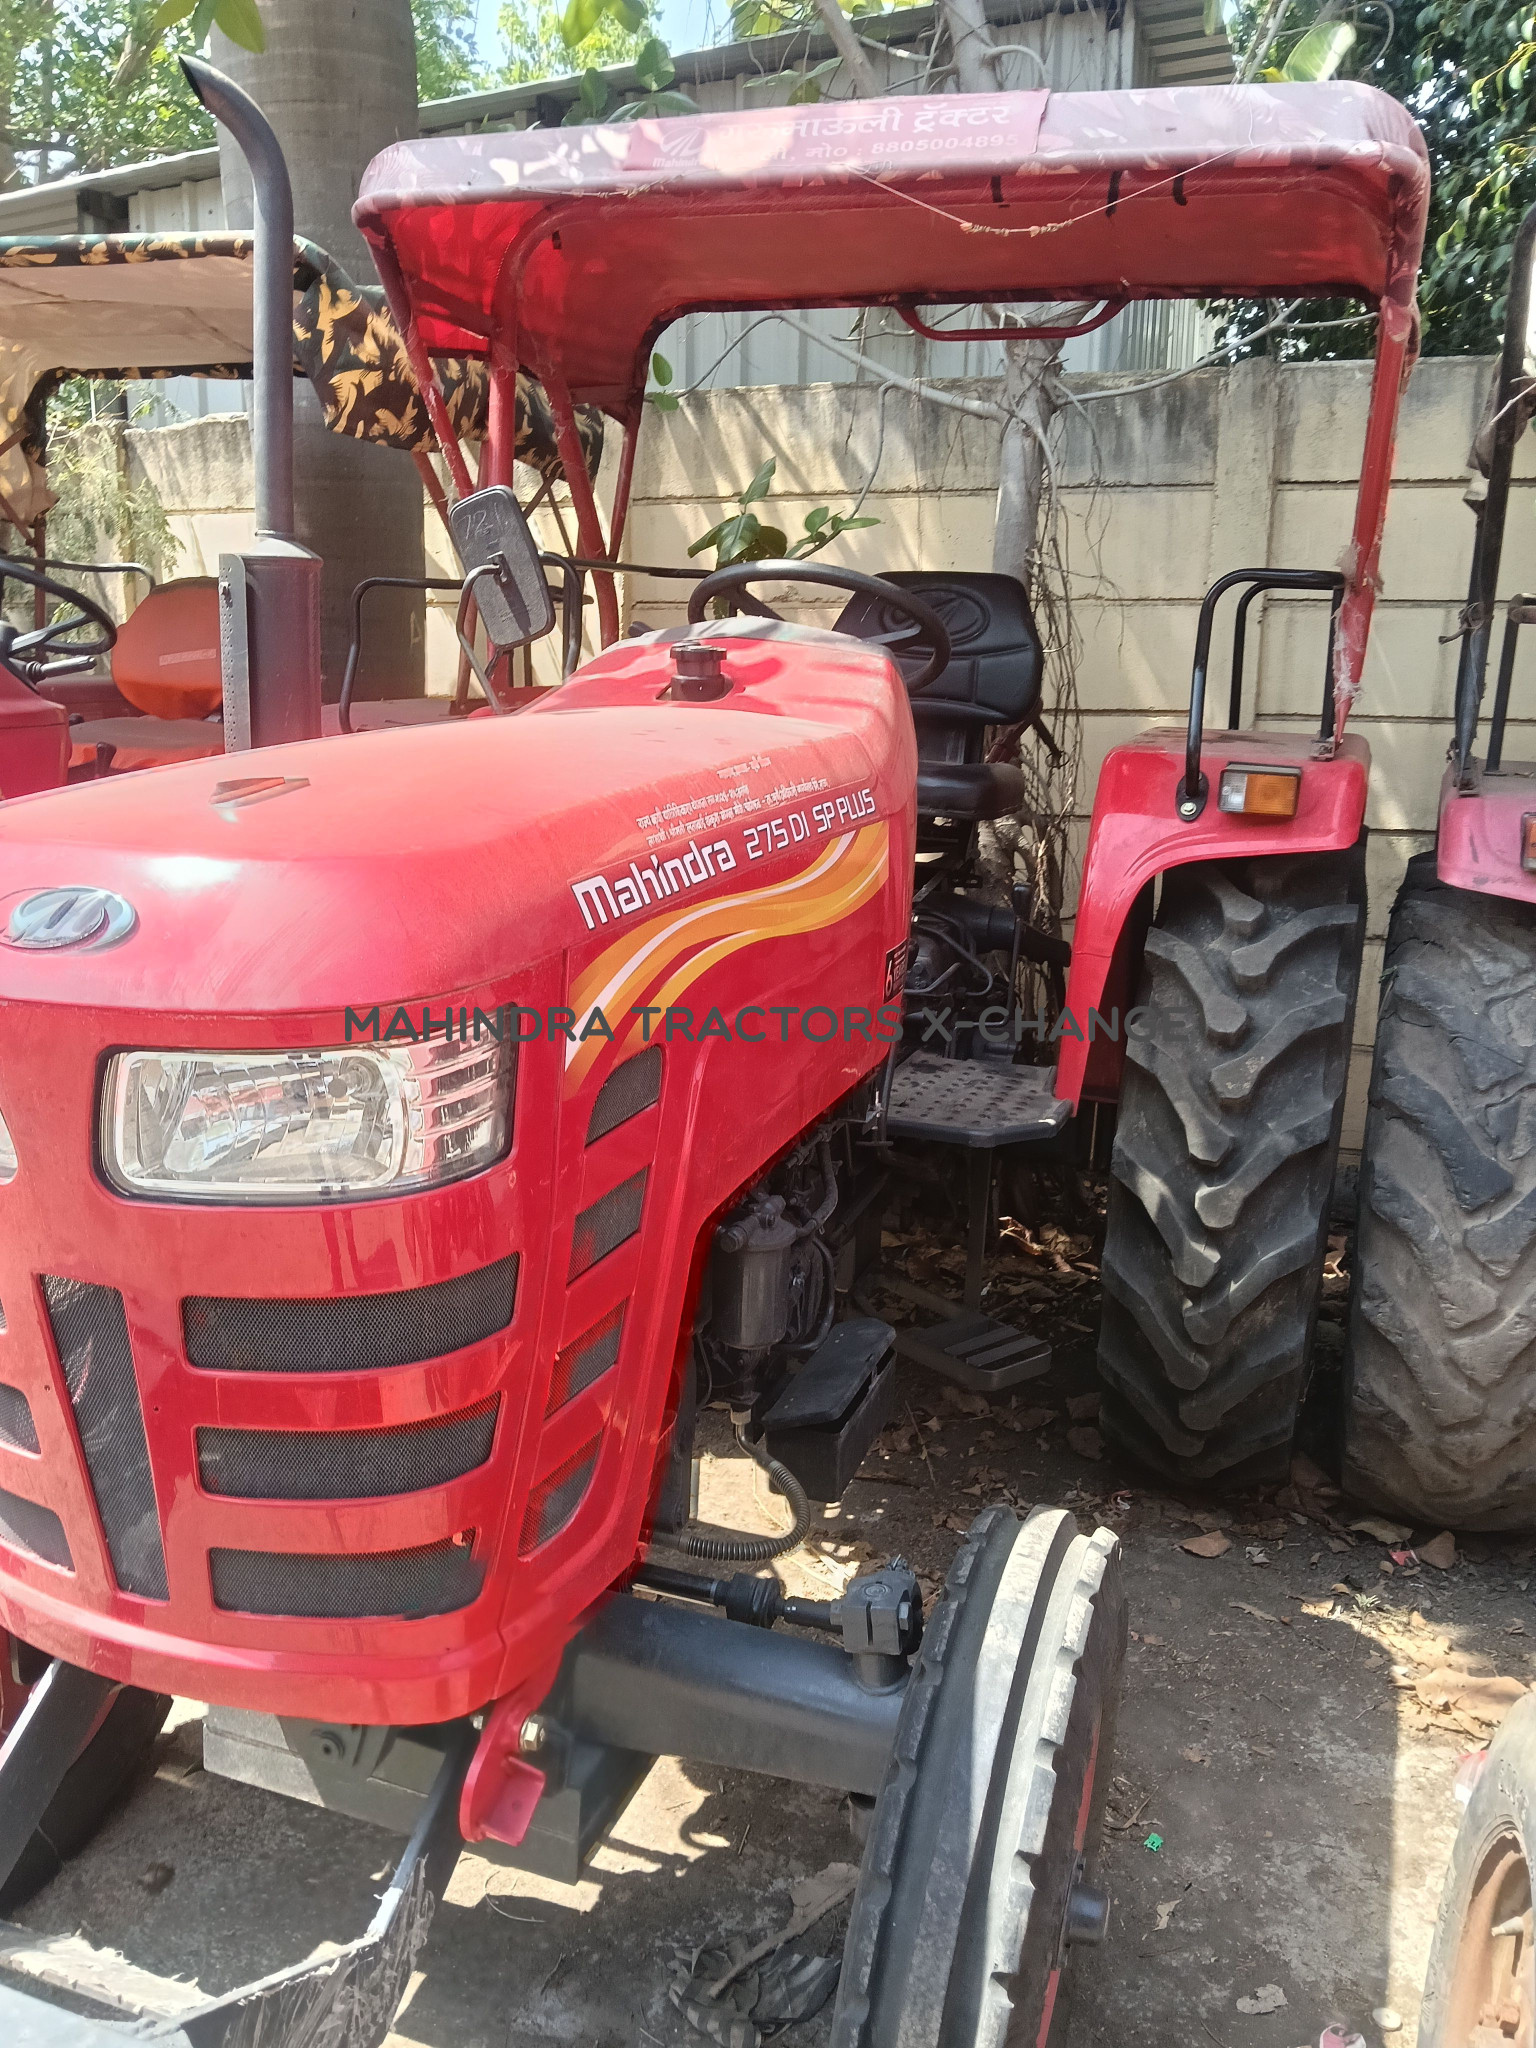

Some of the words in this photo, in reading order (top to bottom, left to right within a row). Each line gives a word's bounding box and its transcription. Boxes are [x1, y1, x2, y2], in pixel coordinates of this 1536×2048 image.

[913, 102, 1012, 134] ट्रॅक्टर
[872, 134, 1019, 155] 8805004895
[652, 156, 704, 169] Mahindr
[571, 840, 737, 930] Mahindra
[743, 821, 790, 860] 275
[789, 810, 811, 843] DI
[812, 801, 835, 833] SP
[835, 788, 877, 825] PLUS
